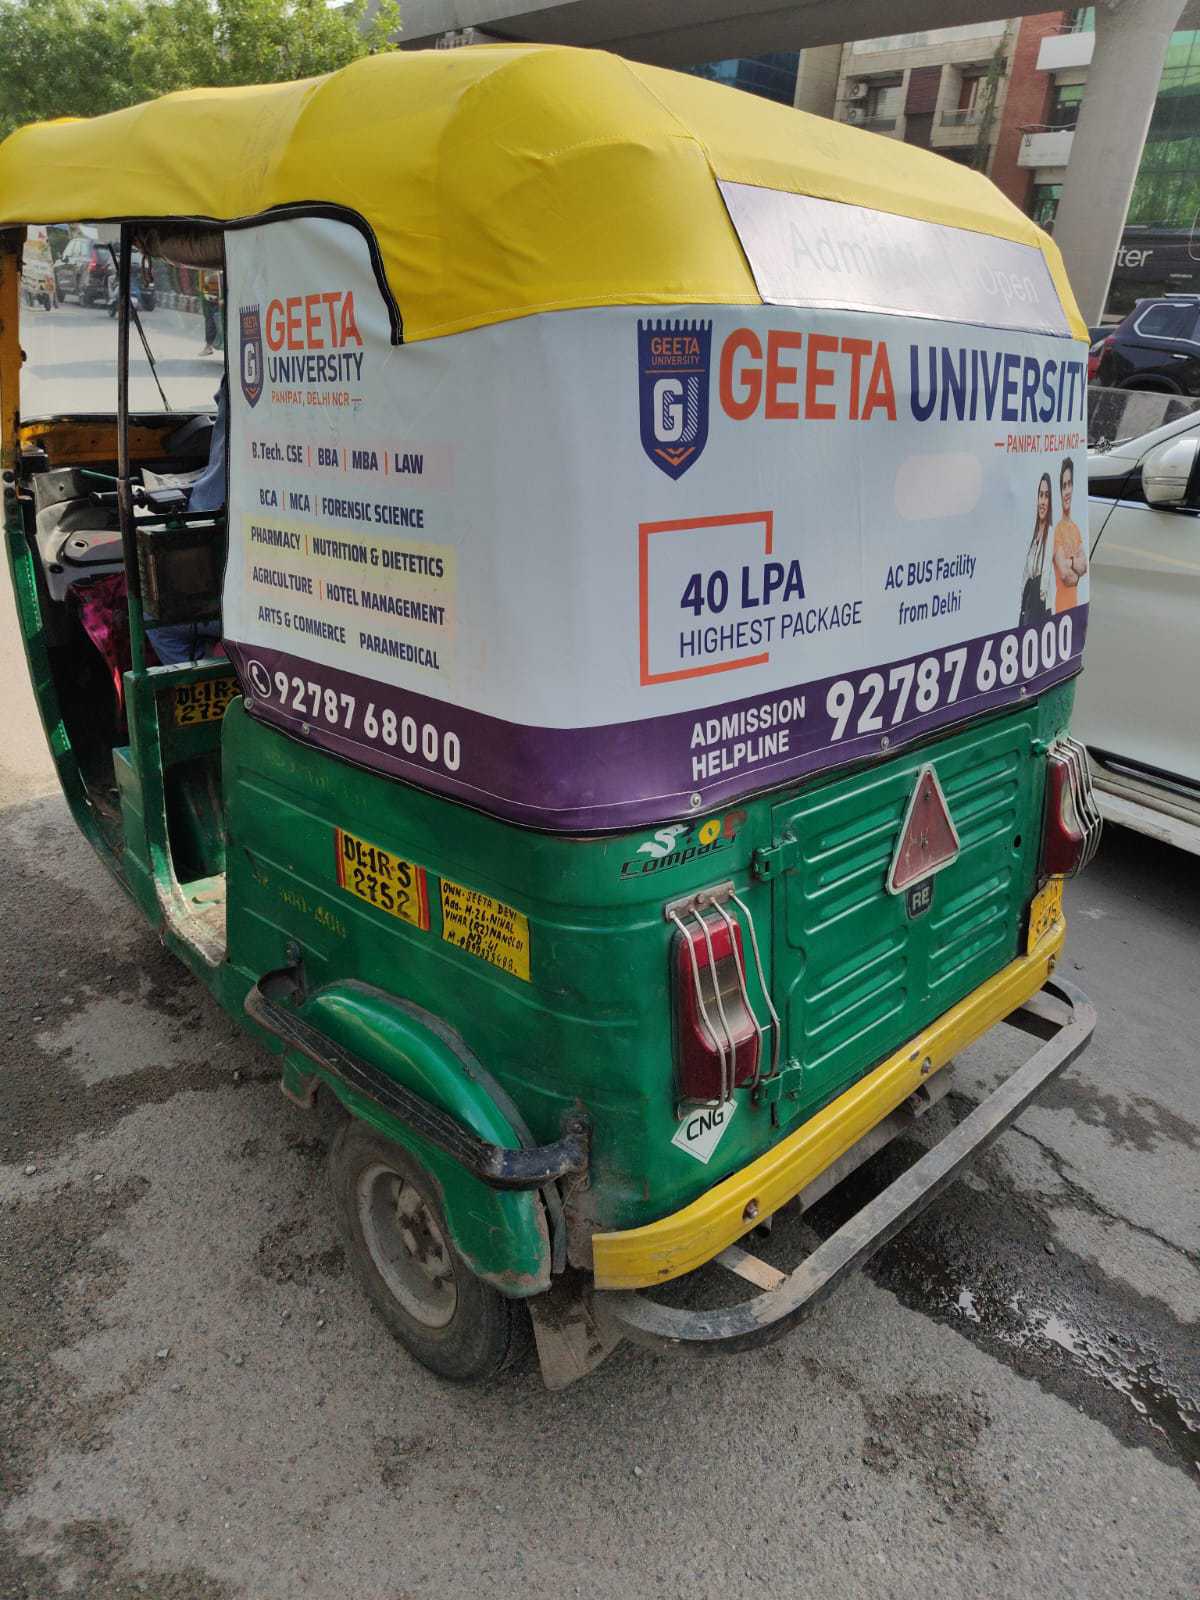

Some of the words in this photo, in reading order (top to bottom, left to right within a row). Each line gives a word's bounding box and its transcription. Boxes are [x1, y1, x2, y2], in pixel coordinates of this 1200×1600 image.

[975, 256, 1039, 307] Open
[265, 290, 363, 351] GEETA
[651, 336, 700, 355] GEETA
[268, 352, 364, 383] UNIVERSITY
[651, 355, 700, 366] UNIVERSITY
[719, 327, 897, 421] GEETA
[910, 344, 1088, 423] UNIVERSITY
[272, 390, 305, 407] PANIPAT,
[307, 391, 330, 406] DELHI
[332, 392, 350, 406] NCR
[252, 441, 285, 462] B.Tech.
[286, 444, 303, 463] CSE
[318, 447, 339, 467] BBA
[352, 450, 379, 471] MBA
[395, 453, 424, 475] LAW
[1007, 433, 1043, 454] PANIPAT,
[1044, 433, 1065, 452] DELHI
[1067, 432, 1079, 449] NCR
[259, 488, 278, 507] BCA
[290, 492, 311, 513] MCA
[322, 497, 371, 522] FORENSIC
[375, 504, 424, 529] SCIENCE
[251, 526, 301, 551] PHARMACY
[313, 537, 367, 564] NUTRITION
[370, 548, 379, 566] &
[382, 550, 444, 578] DIETETICS
[884, 564, 904, 590] AC
[907, 560, 933, 586] BUS
[936, 554, 976, 580] Facility
[252, 566, 313, 595] AGRICULTURE
[326, 583, 359, 606] HOTEL
[361, 591, 445, 626] MANAGEMENT
[680, 570, 729, 616] 40
[741, 559, 806, 609] LPA
[899, 602, 928, 625] from
[932, 590, 961, 617] Delhi
[258, 605, 283, 627] ARTS
[284, 612, 291, 628] &
[293, 614, 346, 644] COMMERCE
[359, 632, 440, 670] PARAMEDICAL
[680, 616, 776, 659] HIGHEST
[780, 600, 863, 639] PACKAGE
[825, 647, 968, 741] 92787
[975, 614, 1073, 693] 68000
[181, 700, 231, 722] 275
[274, 671, 356, 730] 92787
[363, 703, 461, 771] 68000
[690, 695, 806, 749] ADMISSION
[692, 729, 790, 782] HELPLINE
[353, 867, 411, 919] 2752
[497, 903, 517, 920] DEVI
[686, 1110, 723, 1141] CNG
